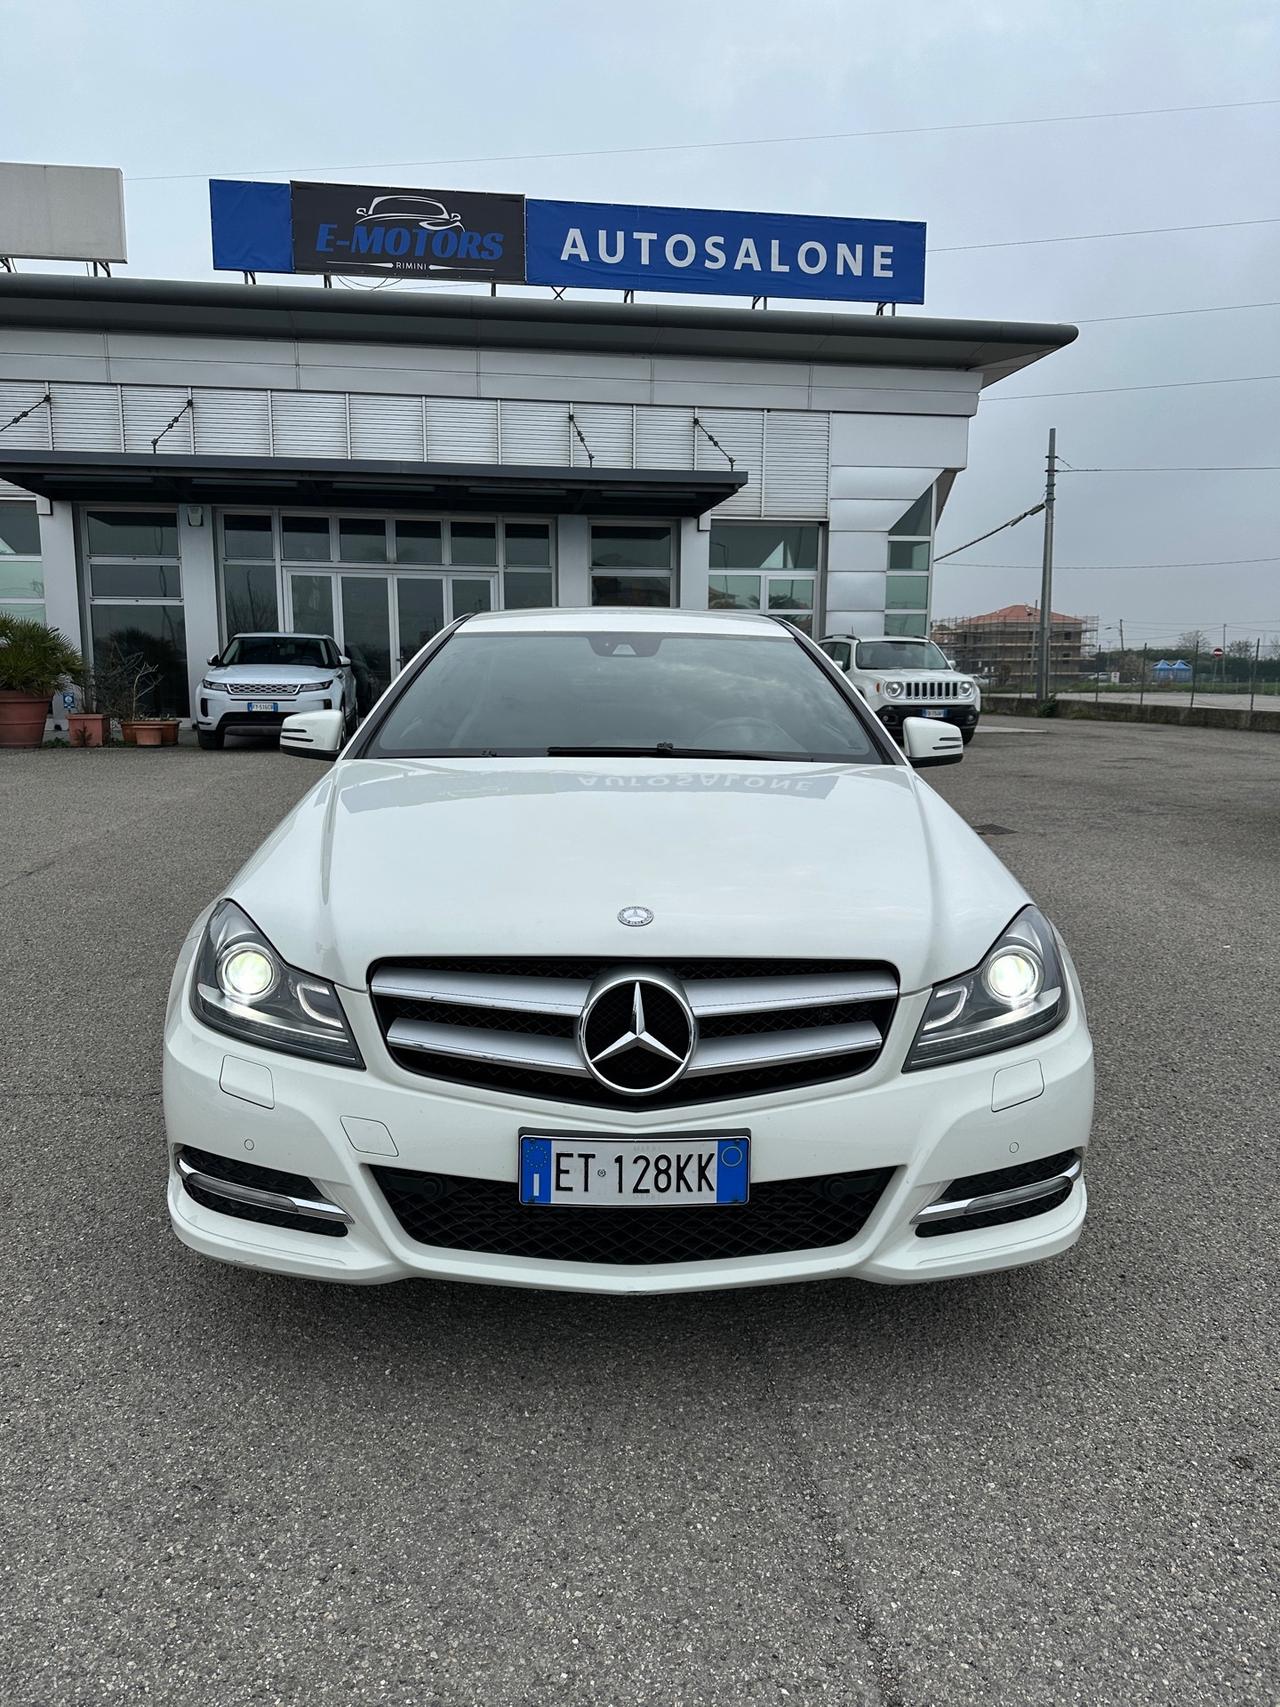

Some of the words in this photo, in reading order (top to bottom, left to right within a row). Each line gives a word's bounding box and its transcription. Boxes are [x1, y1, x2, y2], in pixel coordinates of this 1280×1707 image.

[315, 223, 504, 261] E-MOTORS
[560, 228, 894, 278] AUTOSALONE
[395, 261, 427, 271] RIMINI
[533, 1173, 540, 1197] I
[555, 1152, 596, 1192] ET
[614, 1152, 715, 1194] 128KK
